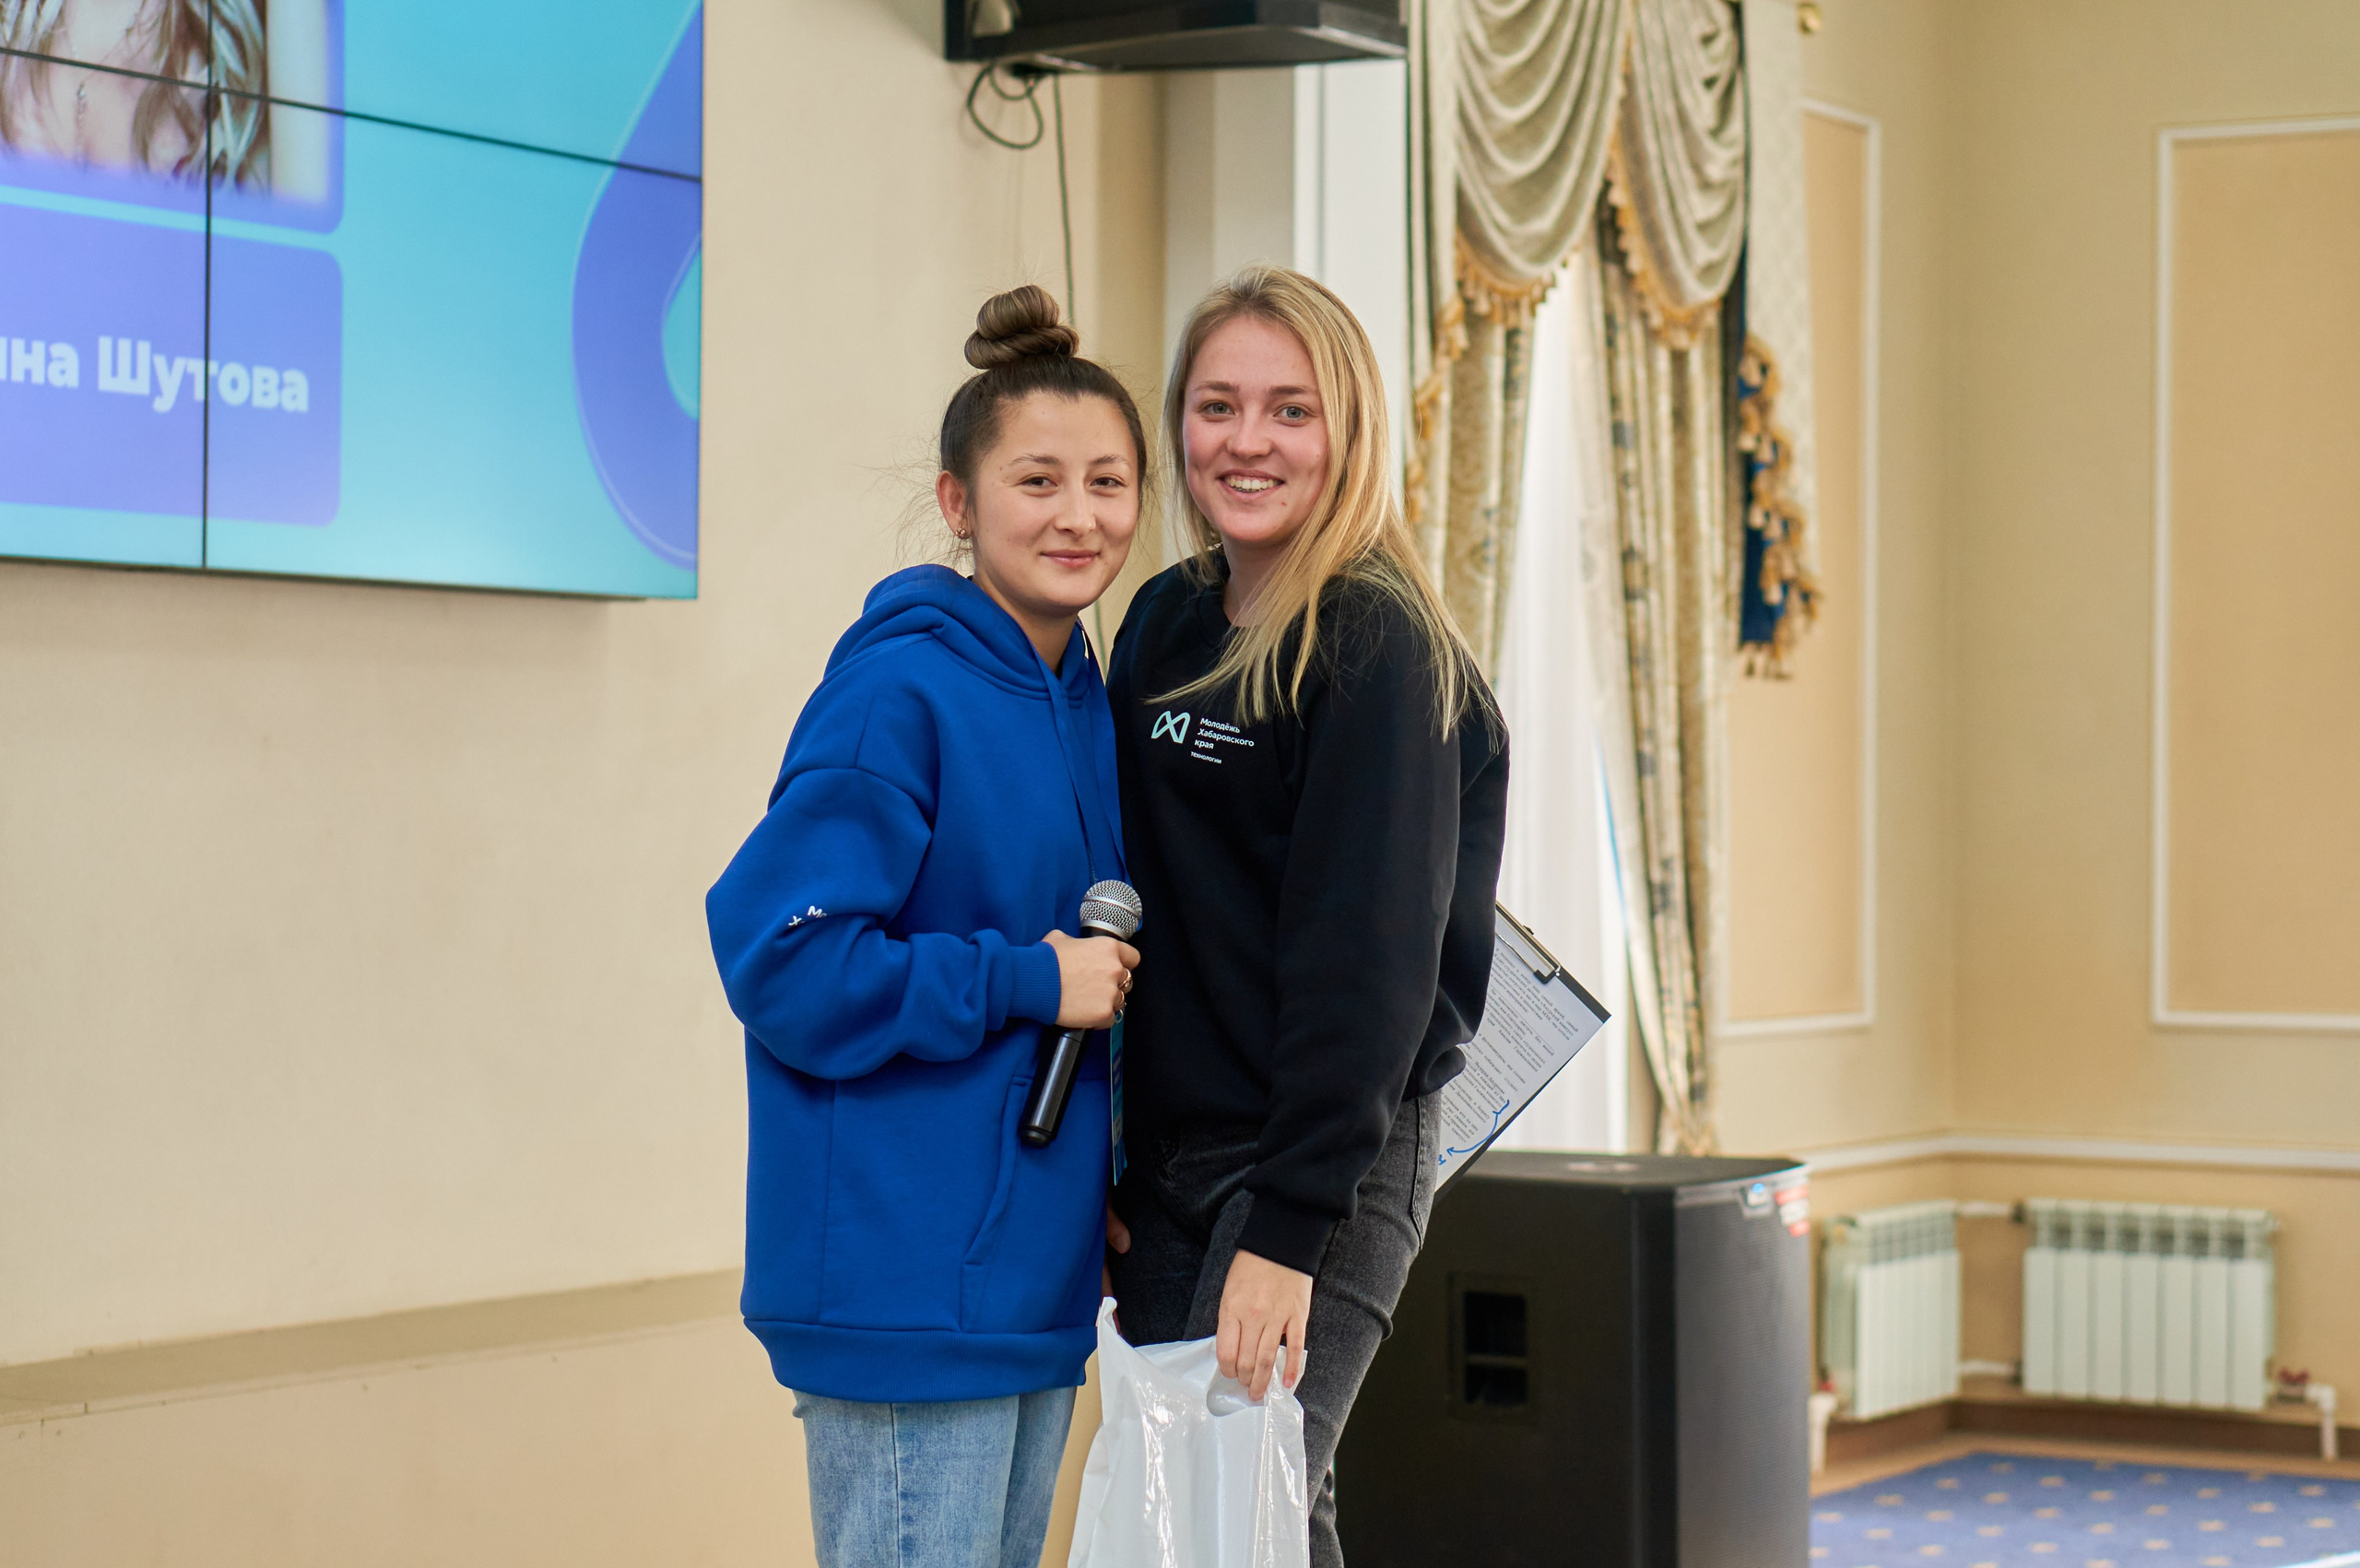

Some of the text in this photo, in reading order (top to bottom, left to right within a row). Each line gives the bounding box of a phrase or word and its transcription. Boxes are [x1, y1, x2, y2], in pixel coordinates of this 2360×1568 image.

[0, 335, 310, 413] на Шутова
[1200, 717, 1241, 734] Молодёжь
[1194, 739, 1214, 749] края
[1198, 728, 1255, 748] Хабаровского
